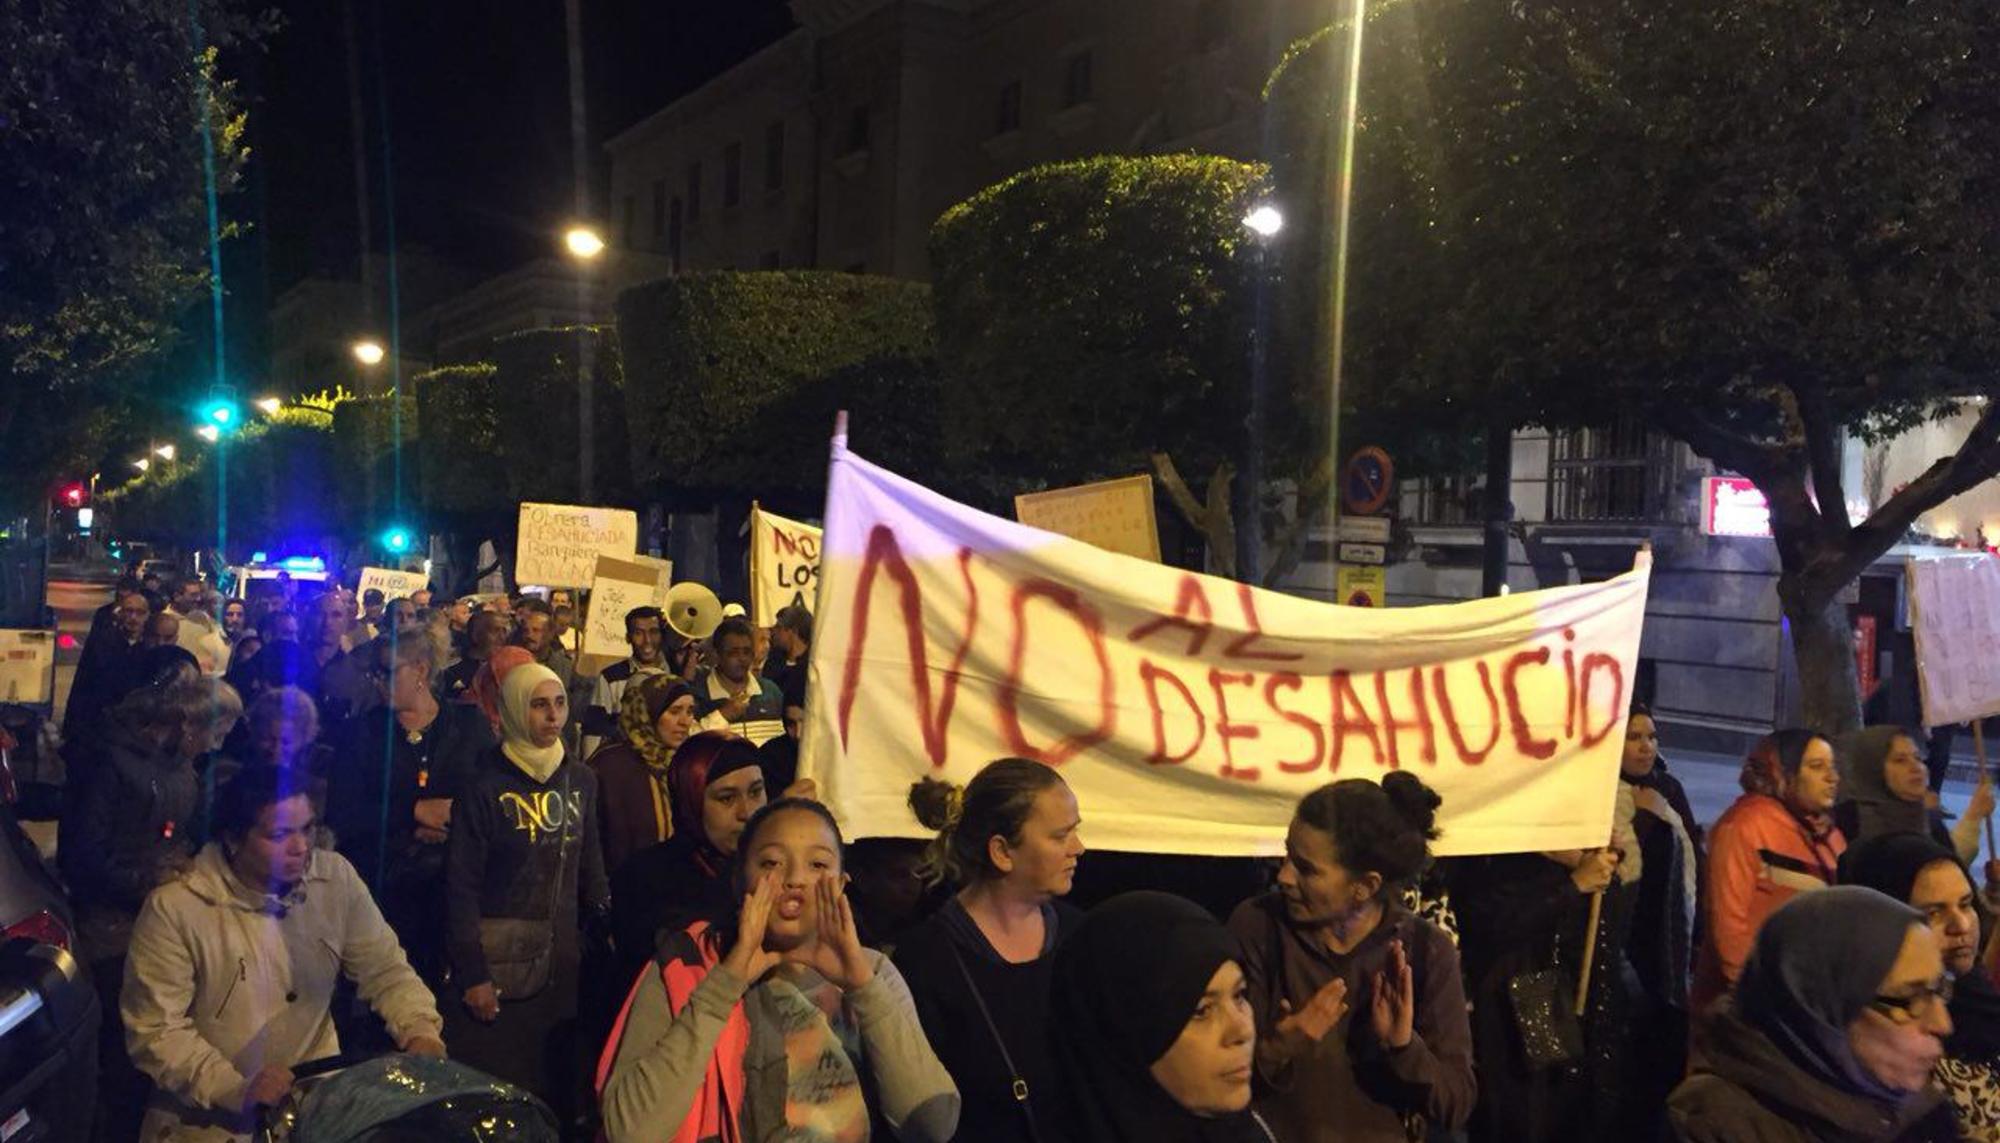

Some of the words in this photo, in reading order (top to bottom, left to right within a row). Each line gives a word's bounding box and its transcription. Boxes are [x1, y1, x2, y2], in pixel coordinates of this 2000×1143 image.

[772, 526, 818, 560] NO
[839, 524, 1116, 769] NO
[1127, 573, 1304, 661] AL
